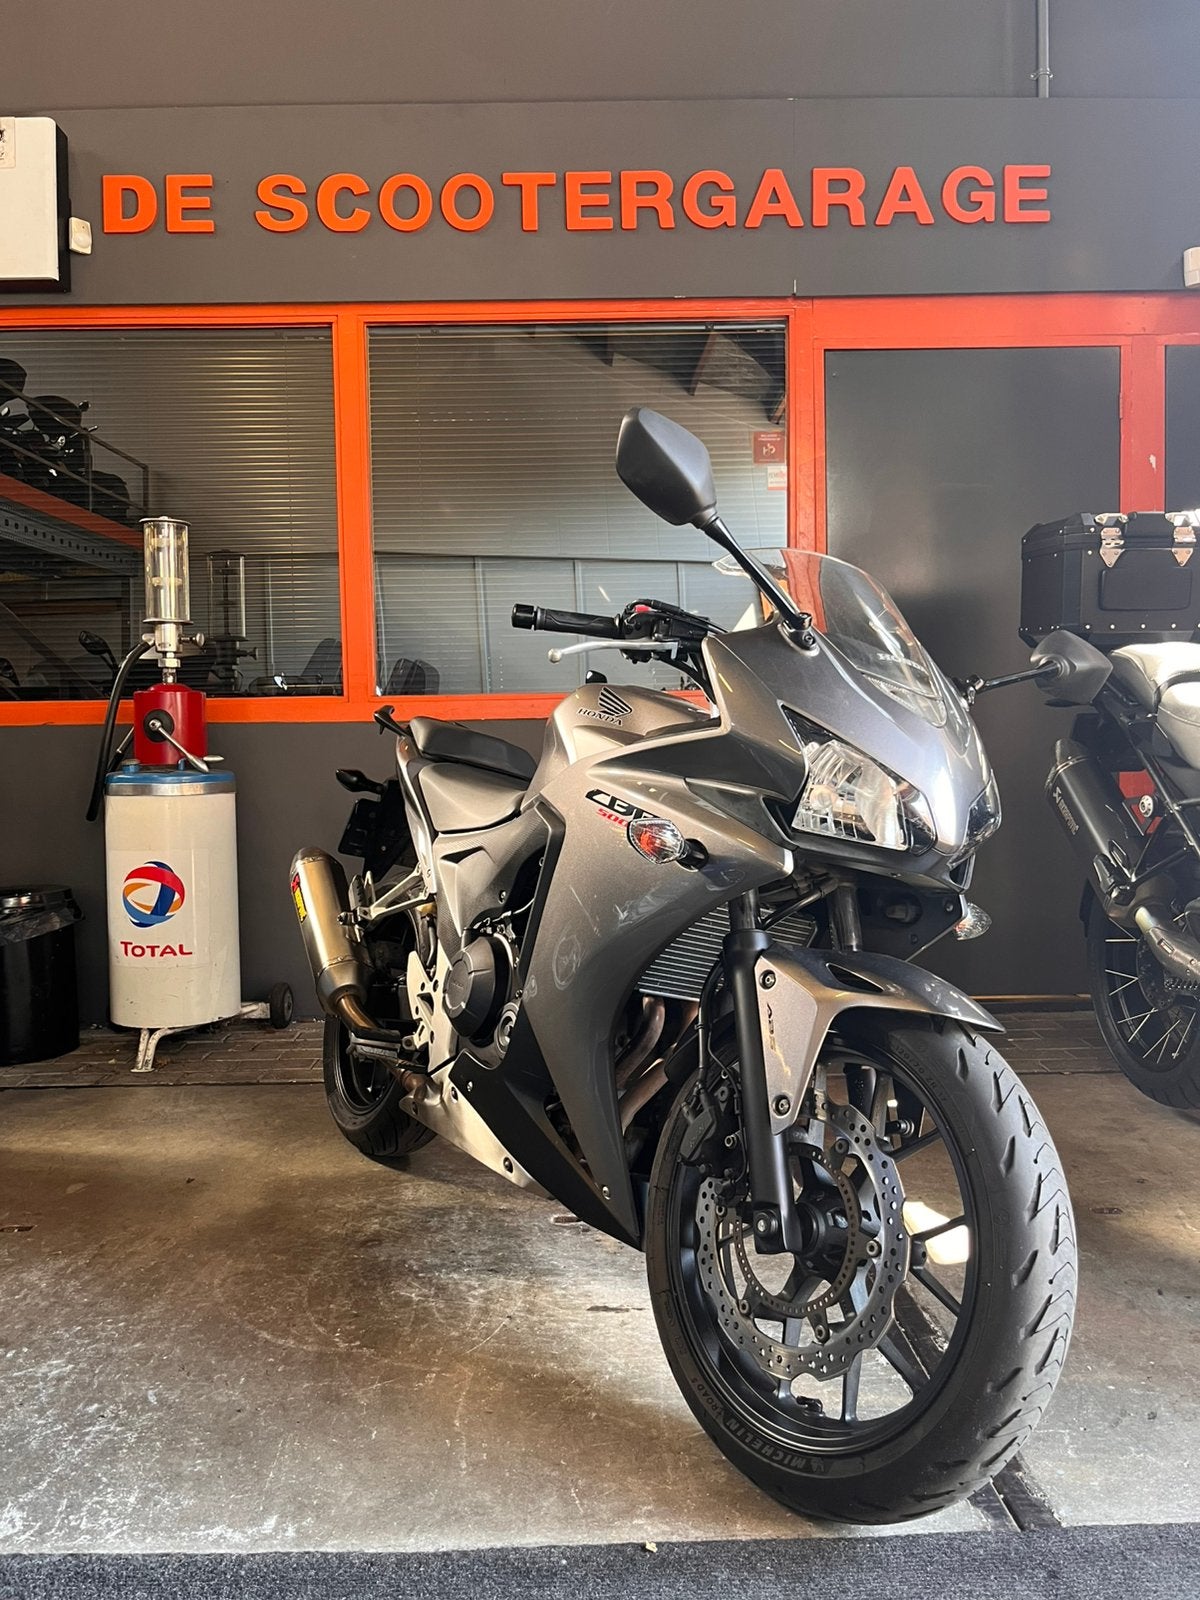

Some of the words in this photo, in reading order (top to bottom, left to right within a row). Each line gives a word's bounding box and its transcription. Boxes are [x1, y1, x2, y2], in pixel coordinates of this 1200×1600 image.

[102, 173, 216, 234] DE
[255, 164, 1052, 234] SCOOTERGARAGE
[577, 707, 623, 726] HONDA
[120, 940, 193, 958] TOTAL
[726, 1418, 805, 1469] MICHELIN
